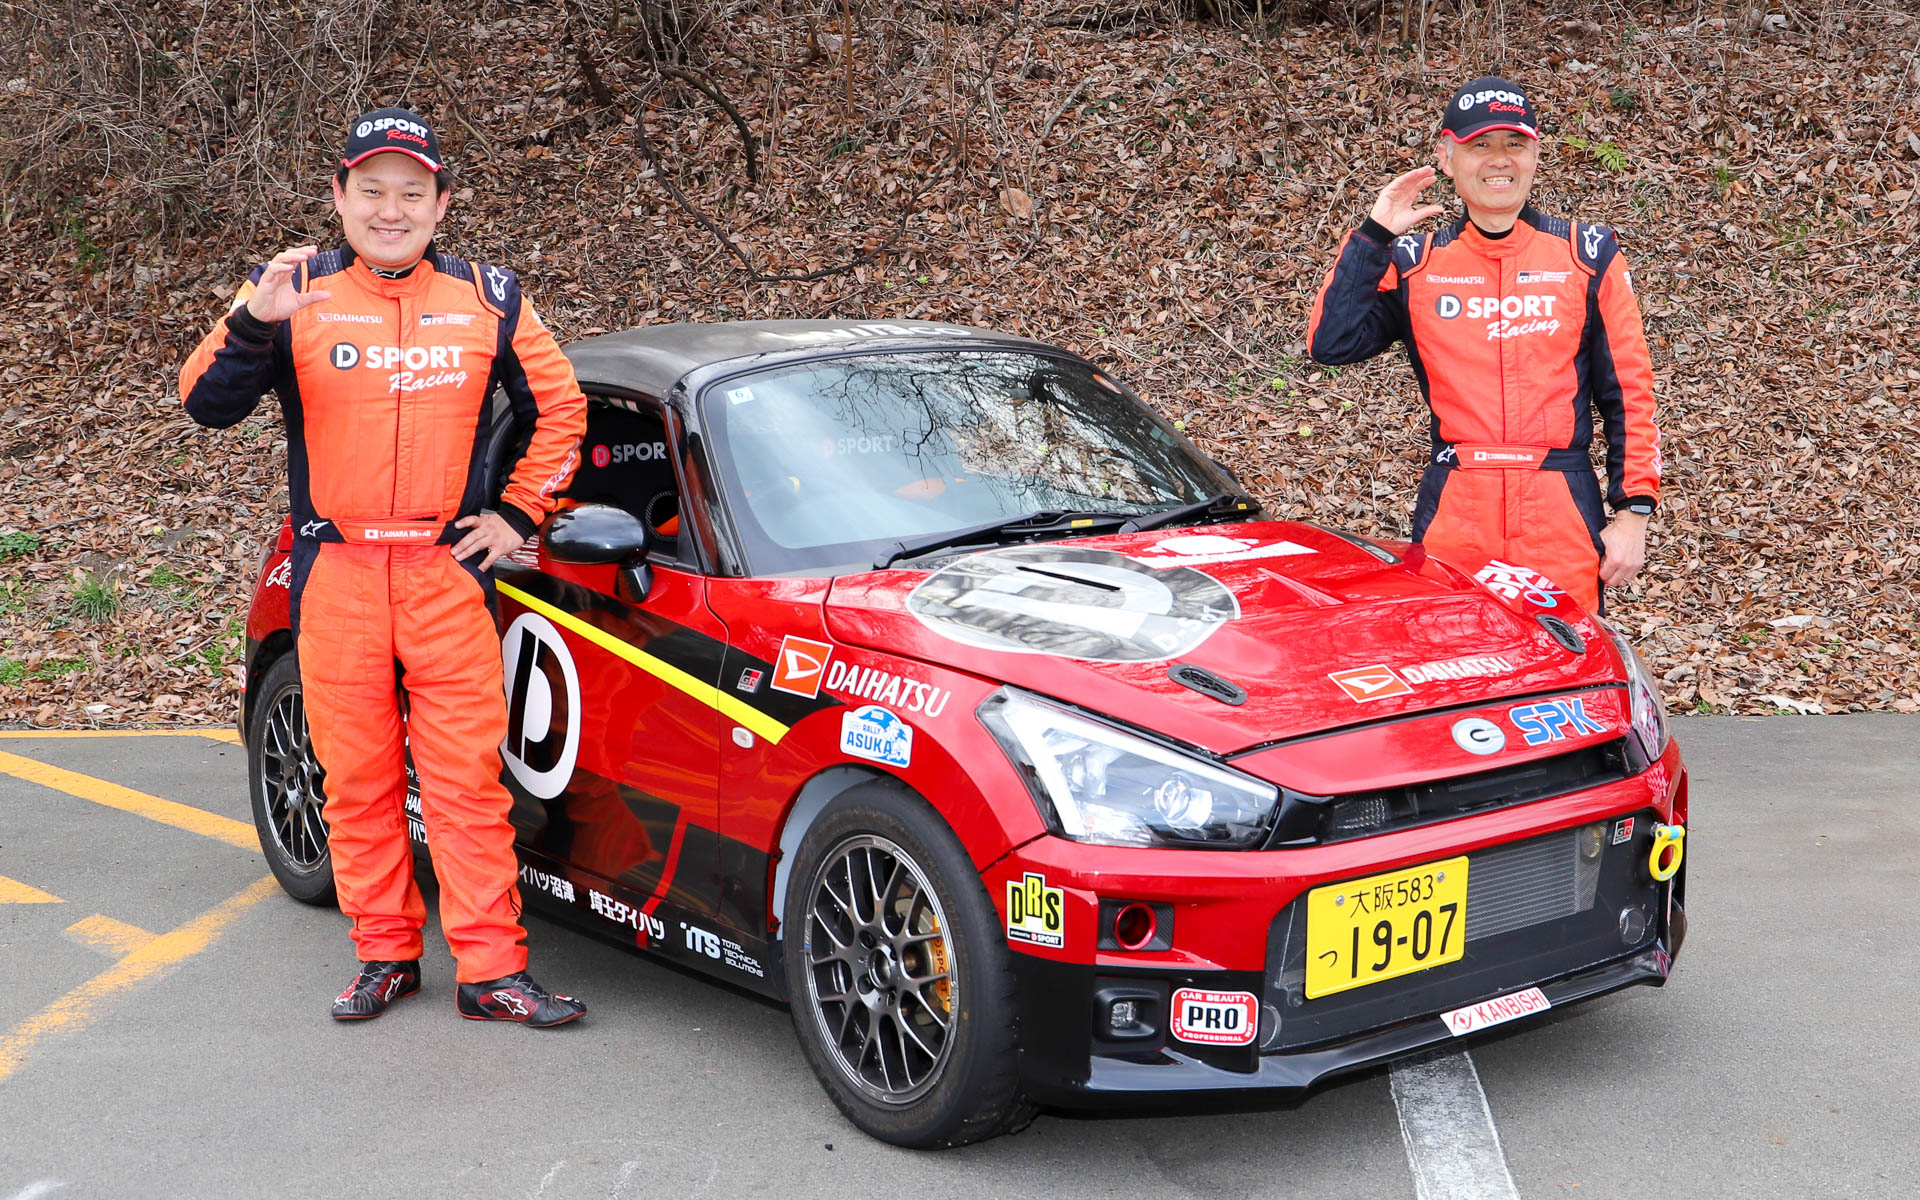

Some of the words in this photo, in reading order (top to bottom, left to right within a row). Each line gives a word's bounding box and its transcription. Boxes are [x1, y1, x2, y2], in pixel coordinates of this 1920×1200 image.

[1475, 90, 1525, 107] SPORT
[1488, 101, 1527, 117] Racing
[374, 118, 428, 138] SPORT
[386, 129, 429, 147] Racing
[1440, 275, 1485, 284] DAIHATSU
[1440, 295, 1460, 317] D
[1466, 295, 1556, 319] SPORT
[333, 314, 383, 324] DAIHATSU
[1486, 319, 1561, 341] Racing
[336, 344, 358, 368] D
[365, 345, 463, 370] SPORT
[388, 370, 468, 393] Racing
[612, 442, 668, 463] SPOR
[1400, 656, 1514, 685] DAIHATSU
[507, 626, 569, 773] D
[826, 660, 951, 717] DAIHATSU
[863, 724, 882, 735] RALLY
[1509, 698, 1607, 746] SPK
[847, 731, 892, 755] ASUKA
[1012, 876, 1059, 931] DRS
[721, 938, 744, 954] TOTAL
[1038, 934, 1060, 945] SPORT
[1318, 950, 1338, 968] つ
[1351, 902, 1458, 979] 19-07
[723, 947, 761, 969] TECHNICAL
[725, 957, 764, 978] SOLUTIONS
[1180, 991, 1203, 1001] CAR
[1205, 994, 1249, 1003] BEAUTY
[1474, 989, 1549, 1025] KANBISHI
[1188, 1005, 1239, 1030] PRO
[1183, 1031, 1243, 1042] PROFESSIONAL
